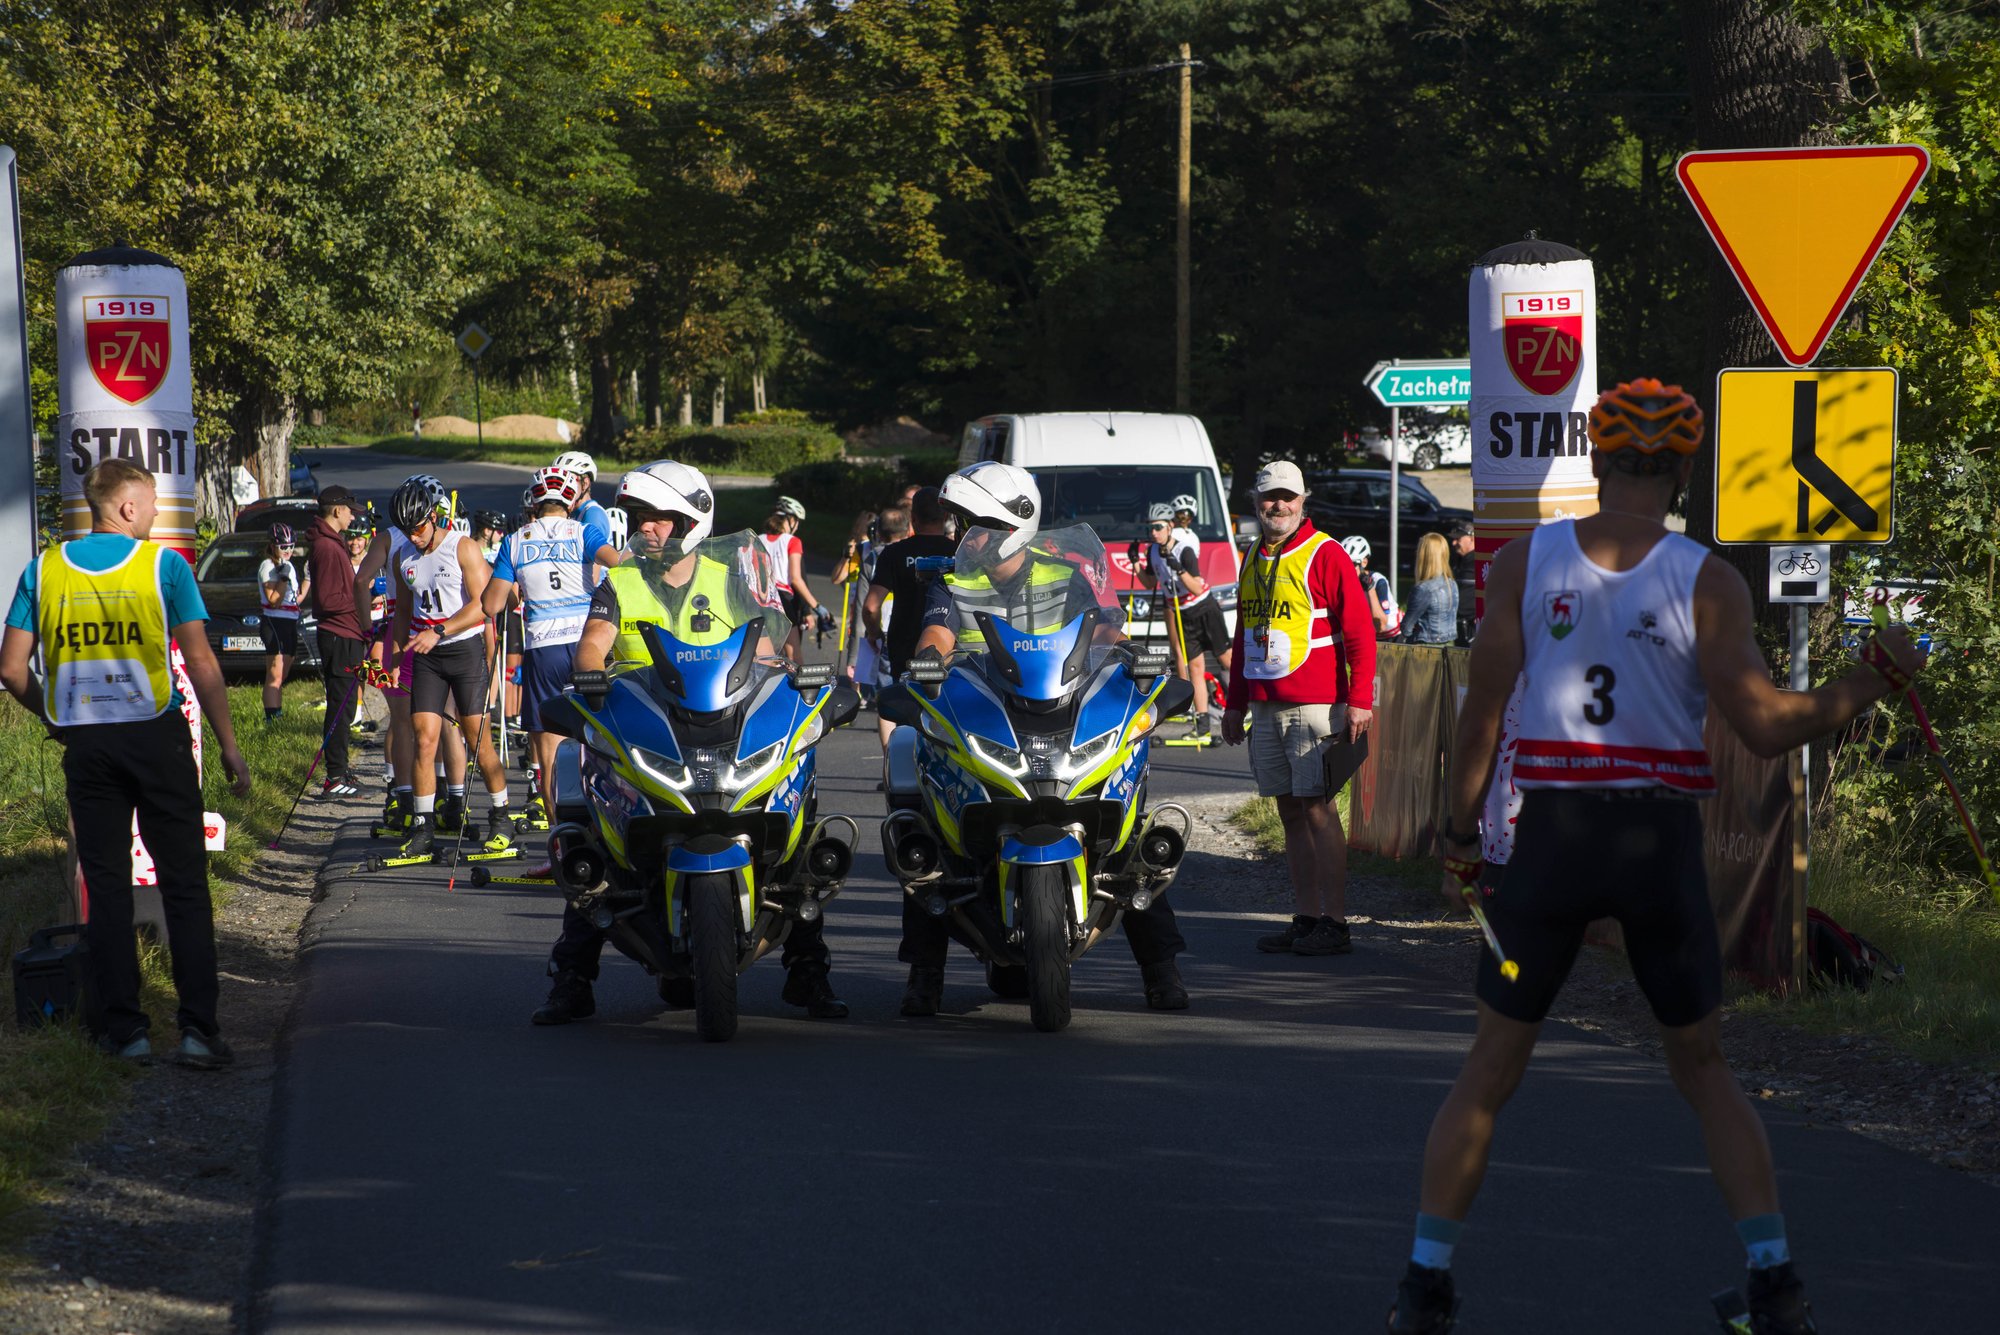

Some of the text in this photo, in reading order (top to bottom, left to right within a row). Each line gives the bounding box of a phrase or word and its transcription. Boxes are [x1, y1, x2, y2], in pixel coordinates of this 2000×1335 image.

[97, 301, 155, 316] 1919
[1517, 297, 1571, 312] 1919
[99, 331, 161, 382] PZN
[1517, 326, 1575, 377] PZN
[1389, 375, 1471, 397] Zachełm
[1489, 411, 1593, 458] STAR
[71, 427, 188, 476] START
[522, 542, 580, 565] DZN
[549, 571, 562, 590] 5
[421, 588, 443, 613] 41
[1022, 592, 1053, 602] PLICJA
[229, 638, 242, 648] WE
[1013, 639, 1066, 653] POLICJA
[676, 648, 731, 663] POLICJA
[1583, 664, 1616, 726] 3
[1570, 756, 1610, 769] SPORTY
